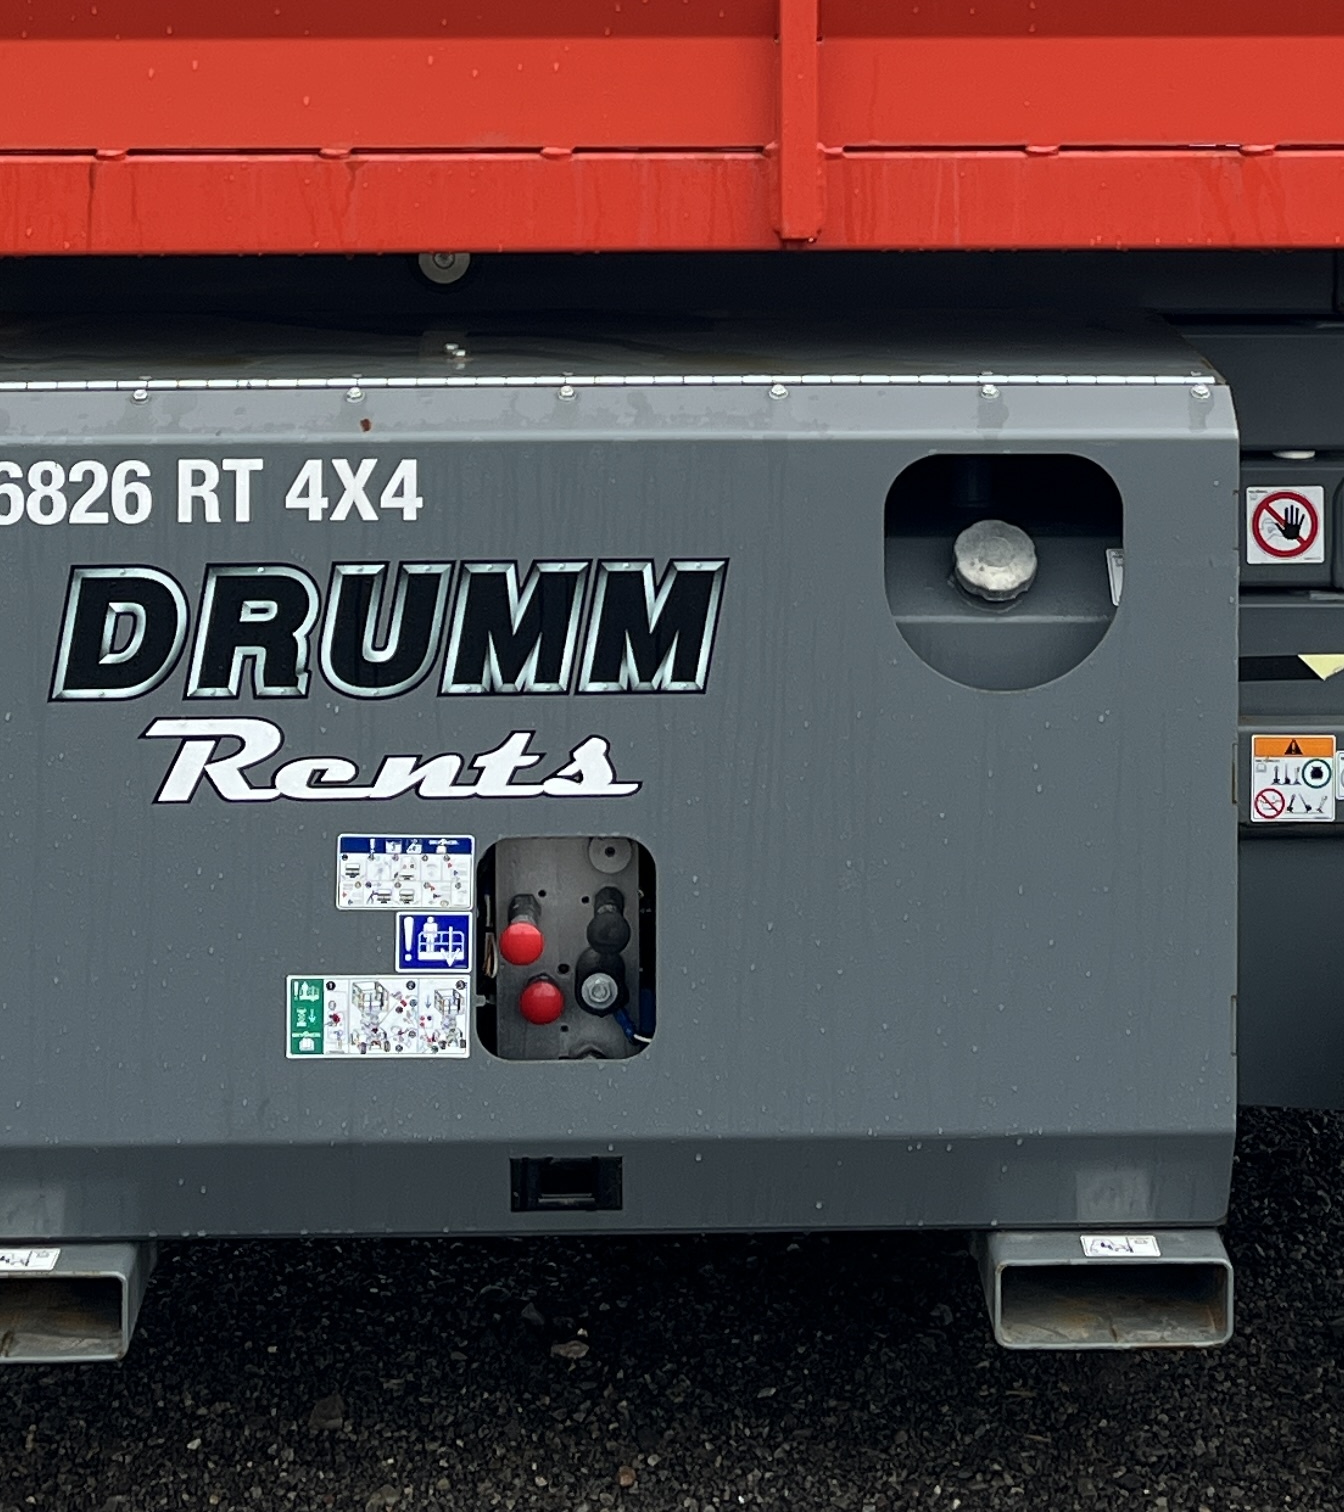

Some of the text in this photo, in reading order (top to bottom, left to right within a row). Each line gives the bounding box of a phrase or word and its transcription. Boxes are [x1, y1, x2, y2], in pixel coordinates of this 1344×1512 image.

[177, 458, 264, 523] RT
[284, 458, 424, 522] 4X4
[48, 558, 730, 702] DRUMM
[139, 717, 643, 803] Rents
